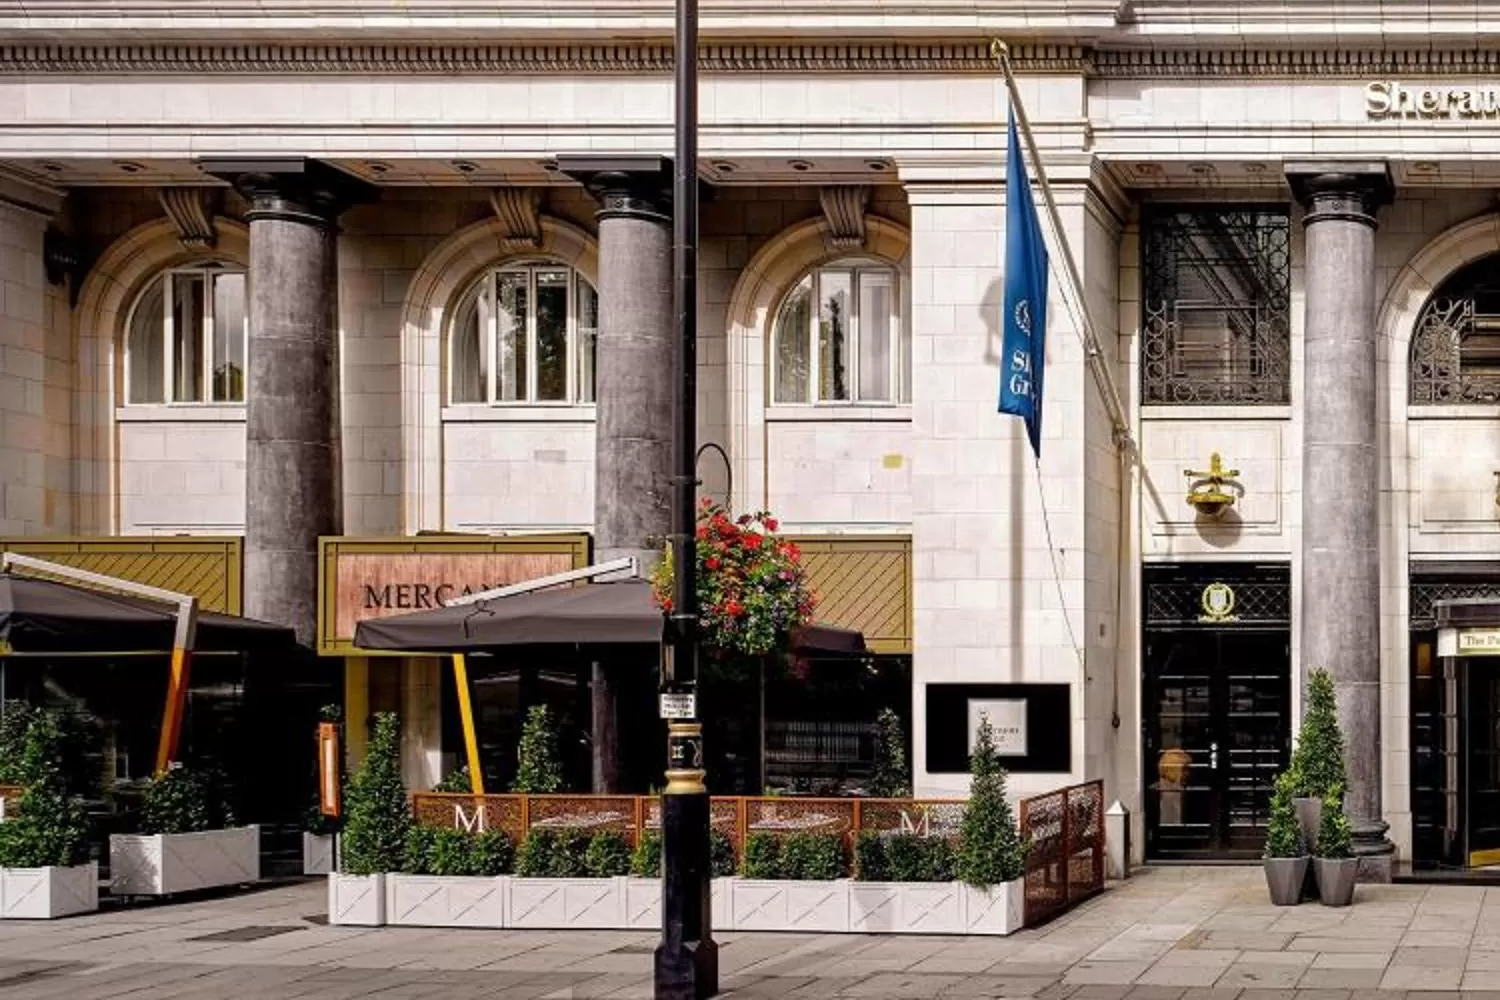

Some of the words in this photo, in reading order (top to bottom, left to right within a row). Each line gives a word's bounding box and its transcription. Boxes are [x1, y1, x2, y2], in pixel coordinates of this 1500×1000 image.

[364, 583, 512, 609] MERC
[1464, 635, 1485, 646] The
[452, 803, 486, 833] M
[898, 809, 929, 839] M
